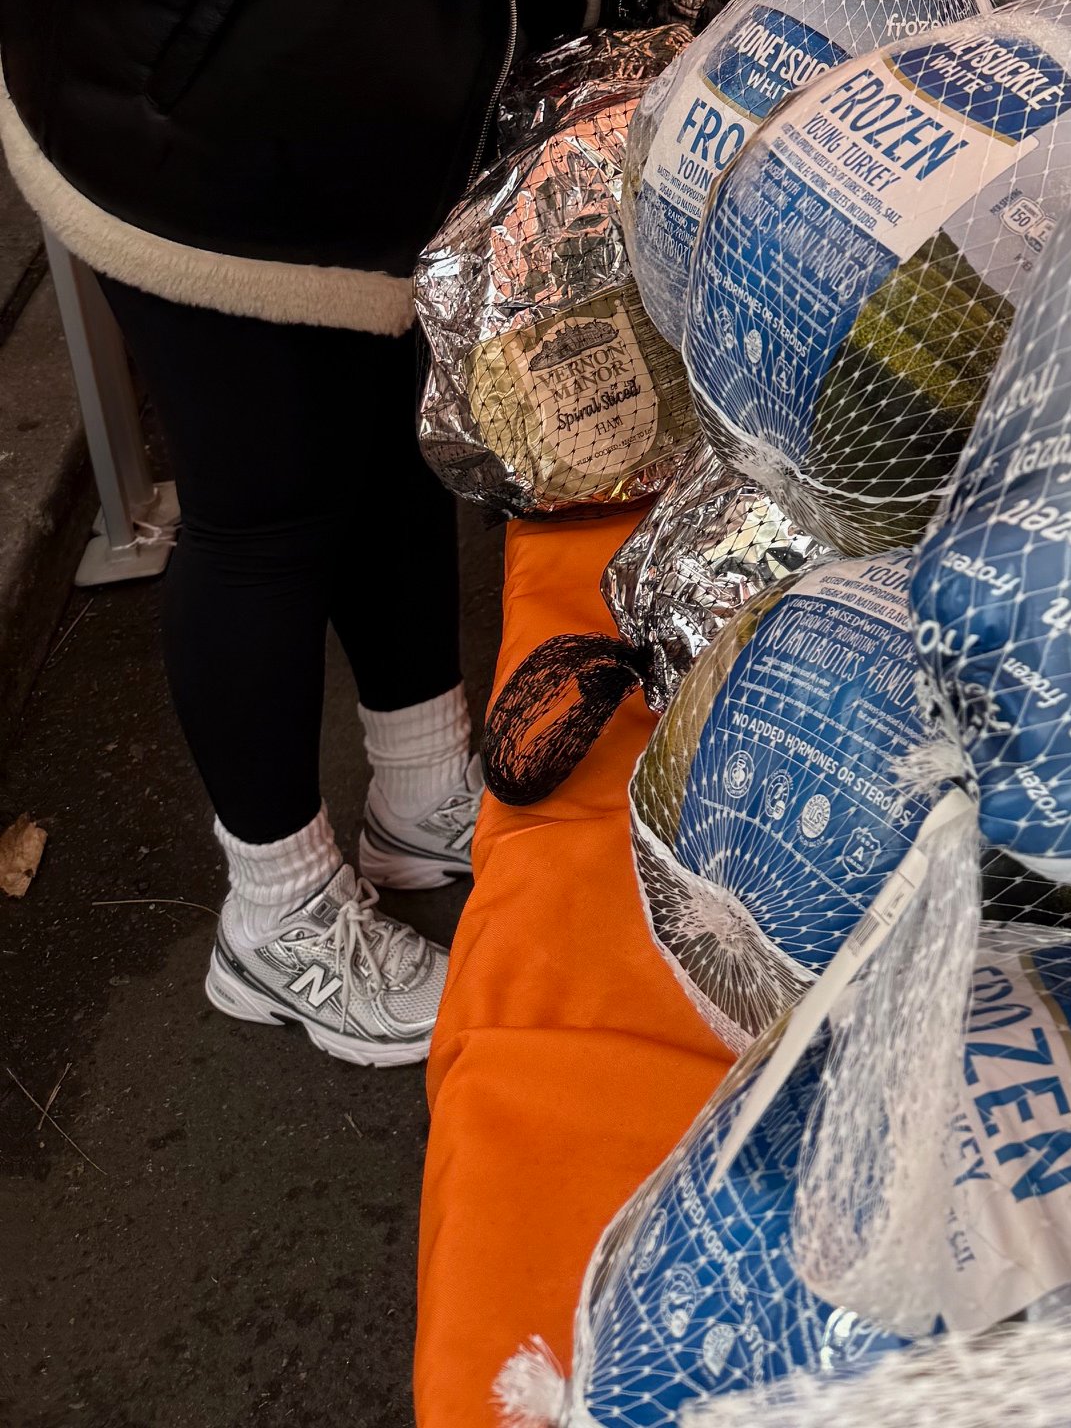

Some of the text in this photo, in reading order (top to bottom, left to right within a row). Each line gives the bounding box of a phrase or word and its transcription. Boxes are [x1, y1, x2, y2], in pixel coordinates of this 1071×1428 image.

[886, 14, 944, 38] froze
[730, 21, 829, 88] HONEYSUC
[929, 54, 986, 94] WHITE
[945, 33, 1064, 111] NEYSUCKLE
[747, 70, 792, 100] WHIT
[676, 97, 745, 170] FRO
[820, 68, 970, 182] FROZEN
[678, 154, 713, 192] YOUN
[802, 111, 902, 193] YOUNG TURKEY
[845, 200, 881, 232] INCLUDED.
[859, 190, 887, 216] BROTH,
[880, 206, 903, 228] SALT,
[1009, 207, 1031, 228] 150
[721, 270, 763, 315] HORMONES
[761, 307, 774, 324] OR
[772, 316, 809, 358] STEROIDS
[536, 341, 627, 389] VERNON
[548, 359, 632, 404] MANOR
[557, 378, 641, 432] Spiral Sliced
[596, 414, 624, 436] HAM
[842, 577, 863, 591] WITH
[860, 582, 910, 609] APPROXIMATE
[859, 564, 911, 593] YOUN
[943, 548, 1022, 597] frozen
[788, 598, 828, 614] TURKEYS
[826, 605, 862, 627] RAISED
[861, 620, 891, 643] WITH
[818, 586, 910, 627] SUGAR AND NATURAL FLAVO
[758, 609, 804, 651] NO
[787, 628, 865, 682] ANTIBIOTICS
[1002, 656, 1068, 710] frozen
[747, 721, 785, 743] ADDED
[785, 735, 840, 775] HORMONES
[836, 766, 854, 784] OR
[1013, 764, 1068, 829] frozen
[852, 845, 865, 861] A
[951, 1111, 992, 1187] KEY
